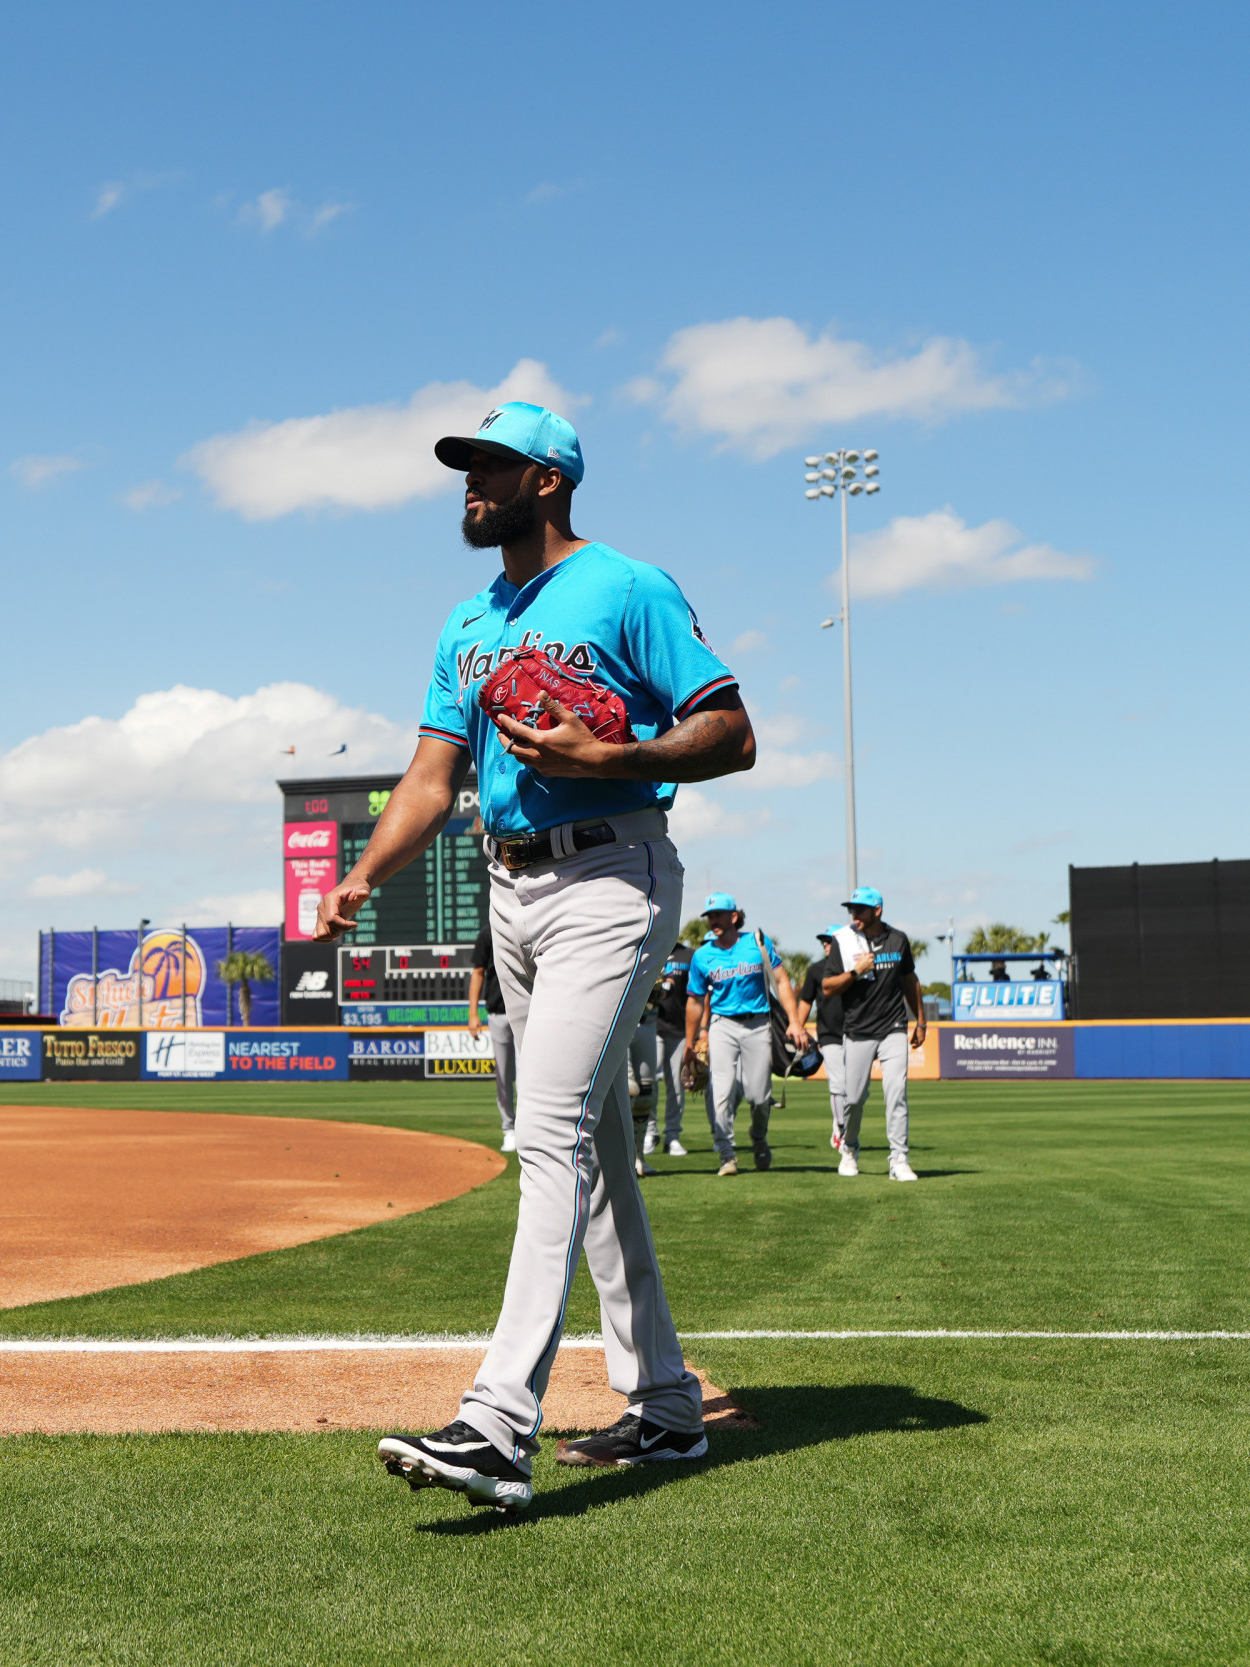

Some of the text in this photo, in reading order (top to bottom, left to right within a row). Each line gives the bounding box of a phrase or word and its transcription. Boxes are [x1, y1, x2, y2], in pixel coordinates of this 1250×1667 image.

[352, 957, 370, 971] 54
[400, 956, 408, 969] 0
[440, 955, 448, 968] 0
[709, 961, 763, 982] Marlin
[101, 973, 149, 1010] Luce
[959, 985, 1054, 1006] ELITE
[387, 1009, 426, 1022] WELCOME
[428, 1008, 439, 1022] TO
[353, 1040, 420, 1054] BARON
[428, 1033, 490, 1054] BARO
[954, 1034, 1036, 1050] Residence
[228, 1042, 300, 1057] NEAREST
[55, 1057, 124, 1066] Patio Bar and Grill
[229, 1056, 337, 1070] TO THE FIELD
[353, 1058, 420, 1066] REAL ESTATE
